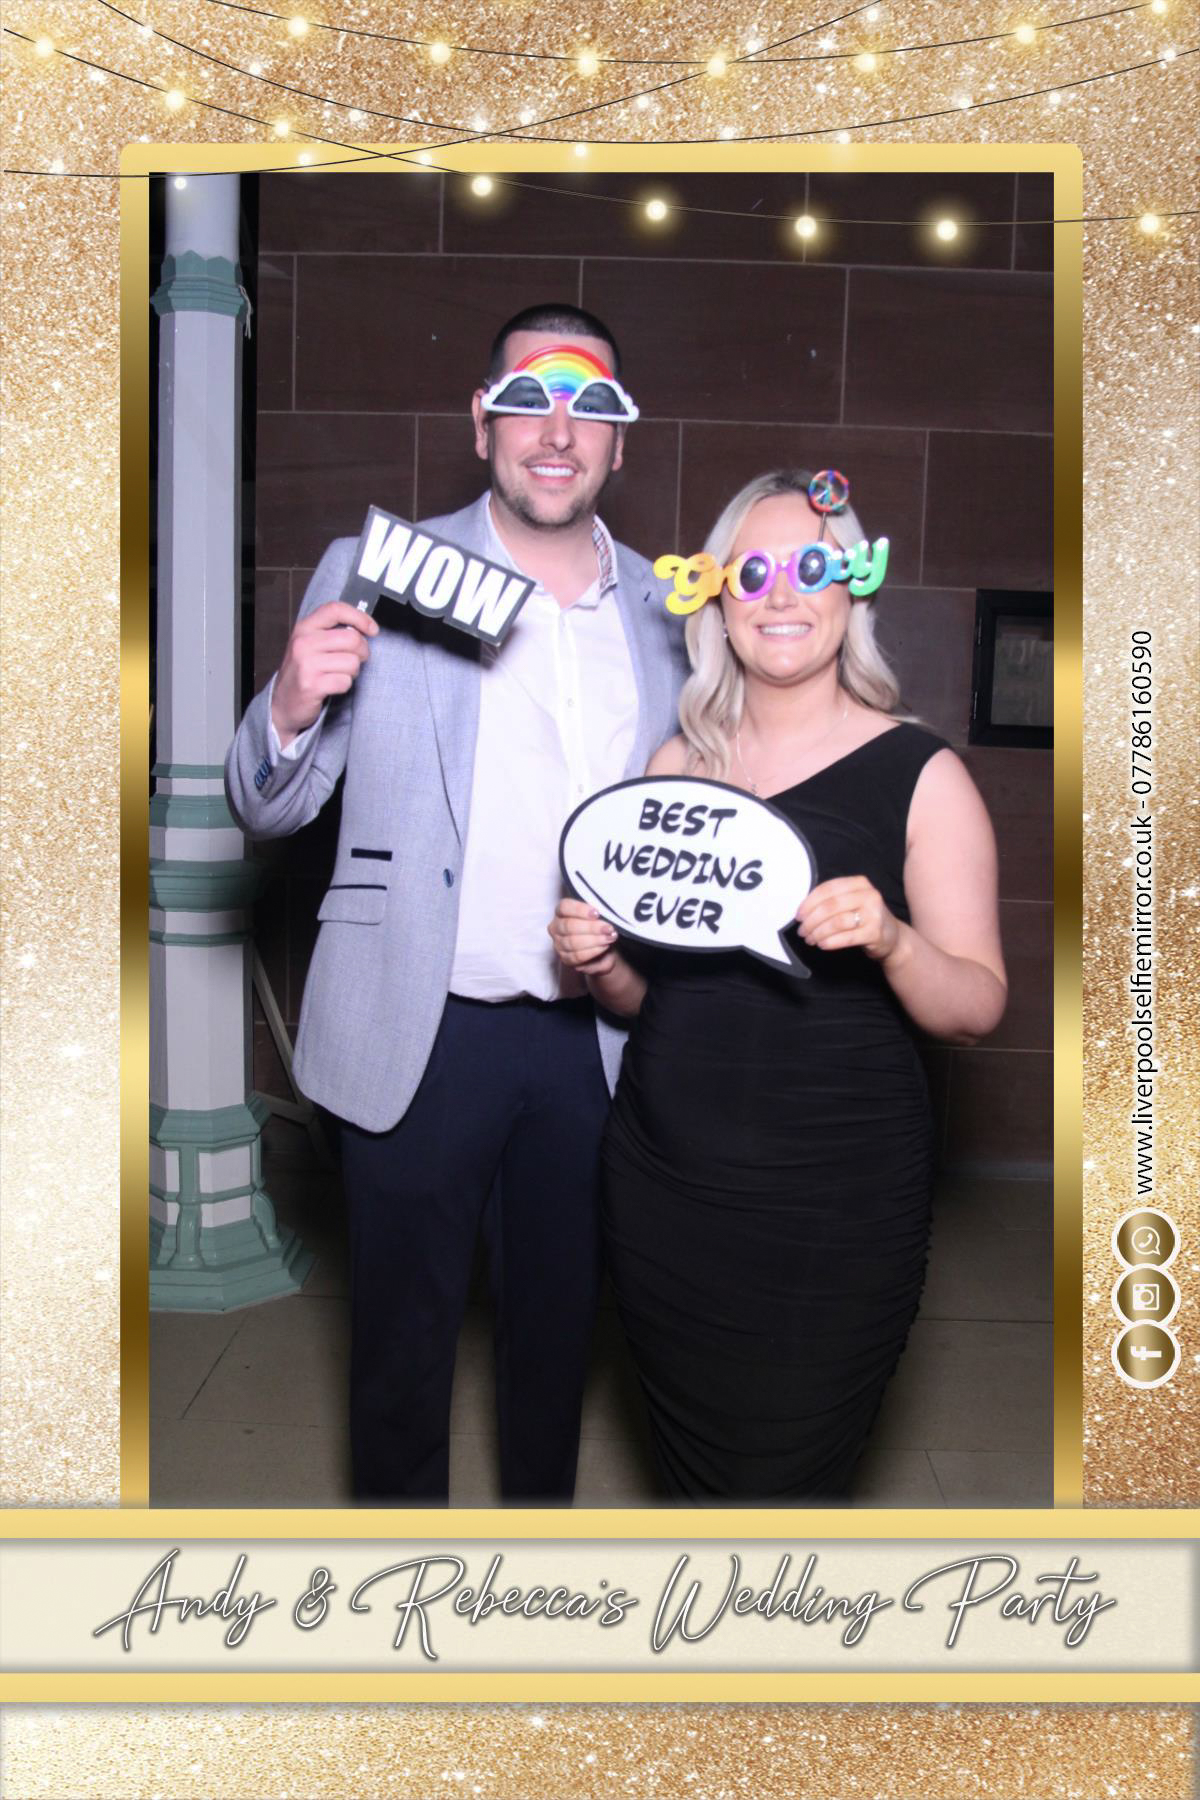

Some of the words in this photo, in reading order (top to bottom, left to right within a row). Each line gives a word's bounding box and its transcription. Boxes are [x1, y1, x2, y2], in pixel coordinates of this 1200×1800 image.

[357, 514, 526, 638] WOW
[638, 798, 738, 838] BEST
[603, 840, 763, 891] WEDDING
[633, 892, 723, 934] EVER
